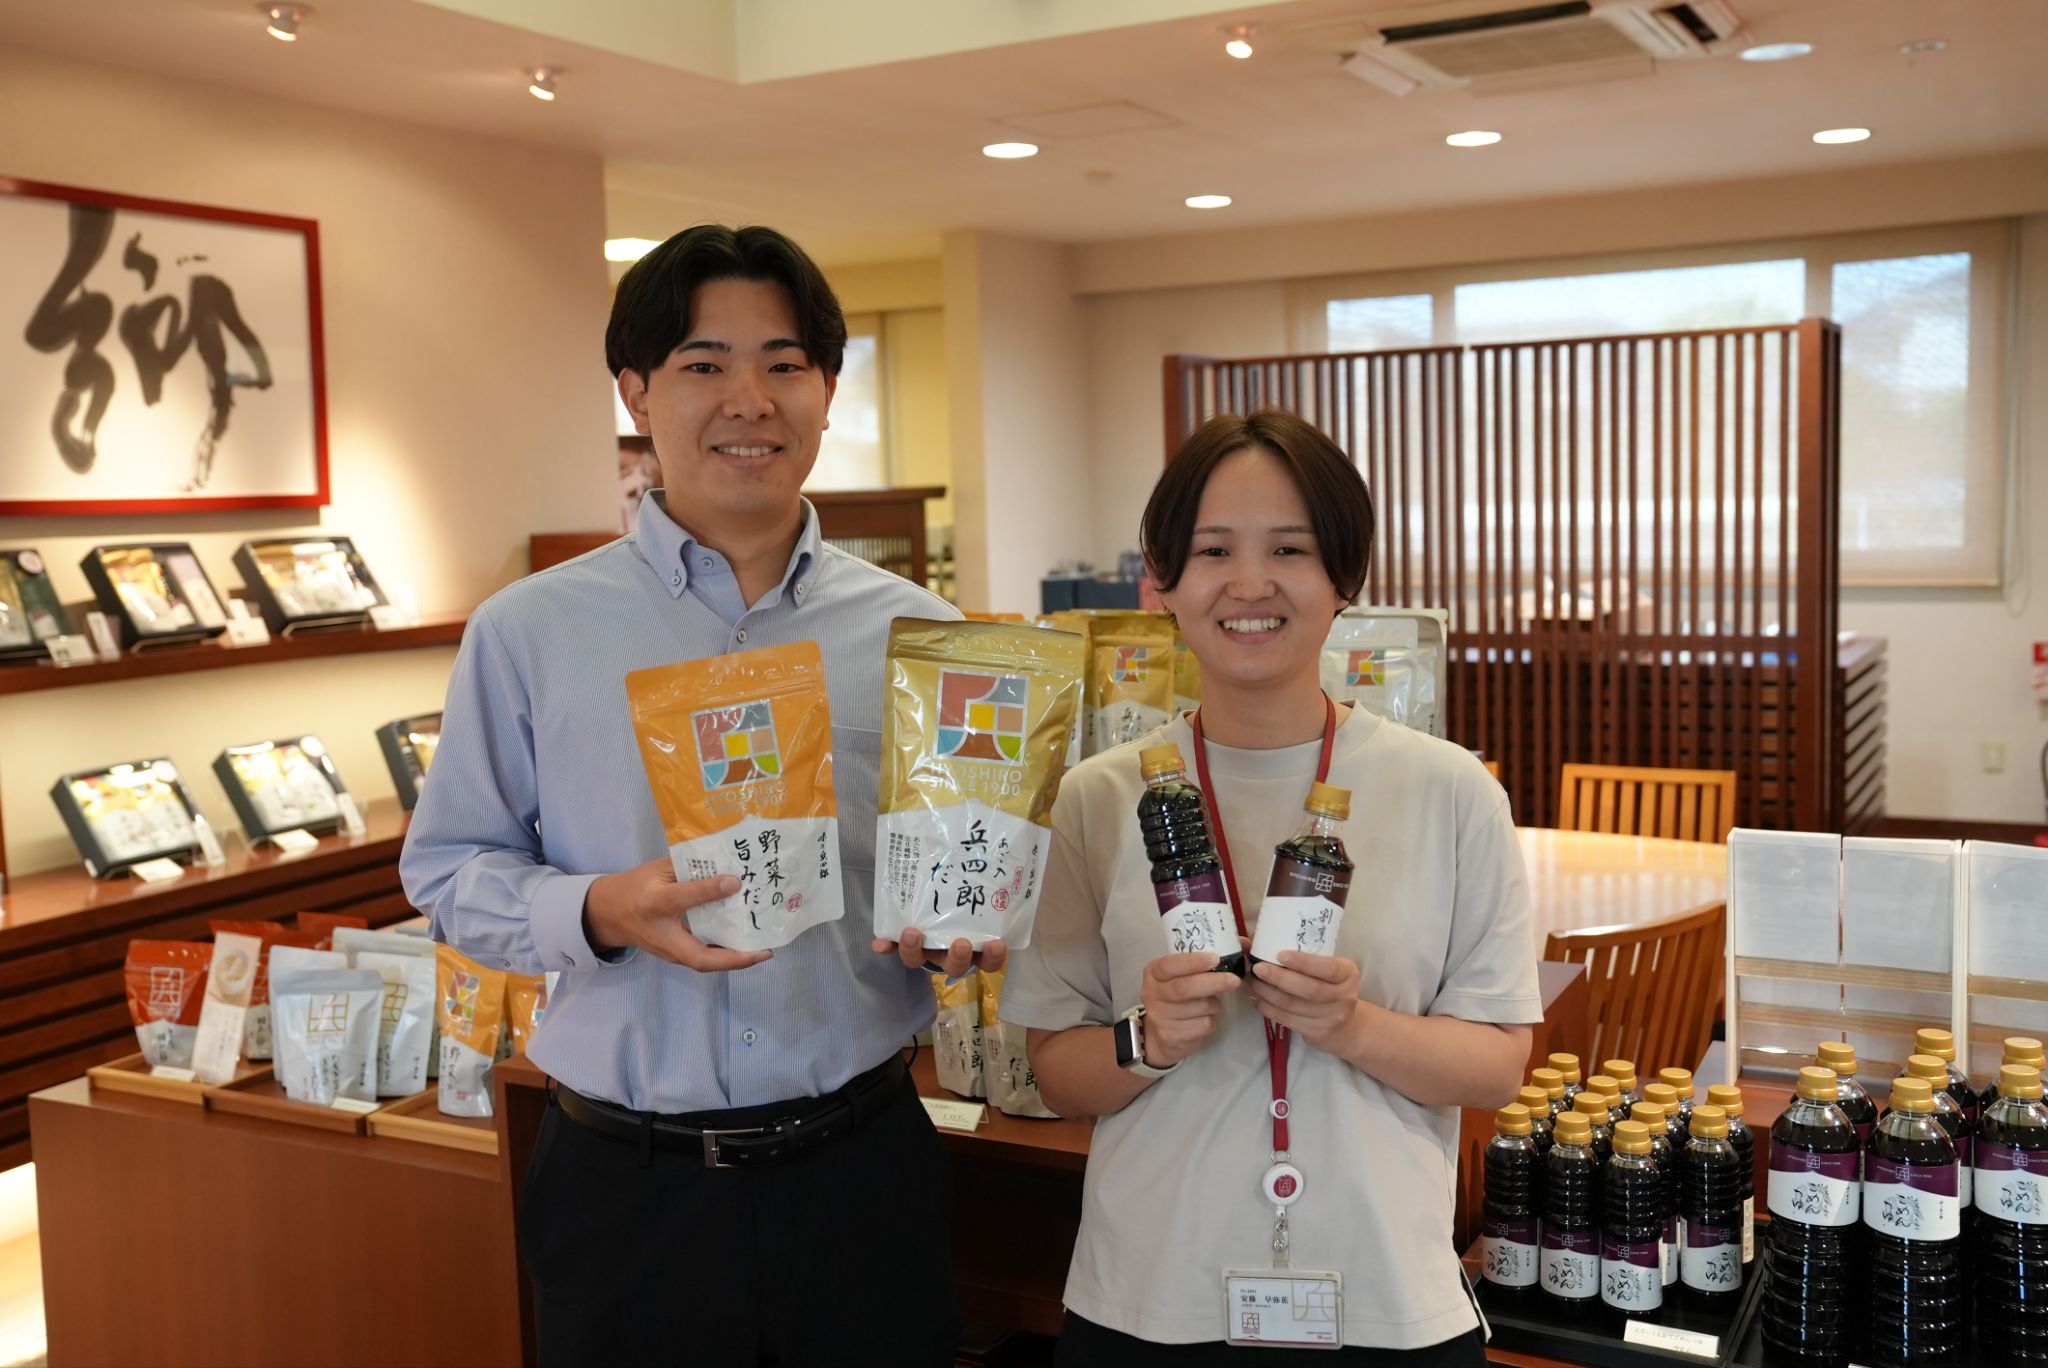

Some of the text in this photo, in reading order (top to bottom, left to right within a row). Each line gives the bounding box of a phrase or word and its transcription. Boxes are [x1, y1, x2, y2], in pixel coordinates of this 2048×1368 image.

[983, 783, 1021, 796] 1900
[734, 838, 762, 930] 旨みだし
[758, 829, 785, 906] 野菜の
[931, 861, 954, 915] だし
[956, 819, 989, 915] 兵四郎
[992, 838, 1010, 878] あご入
